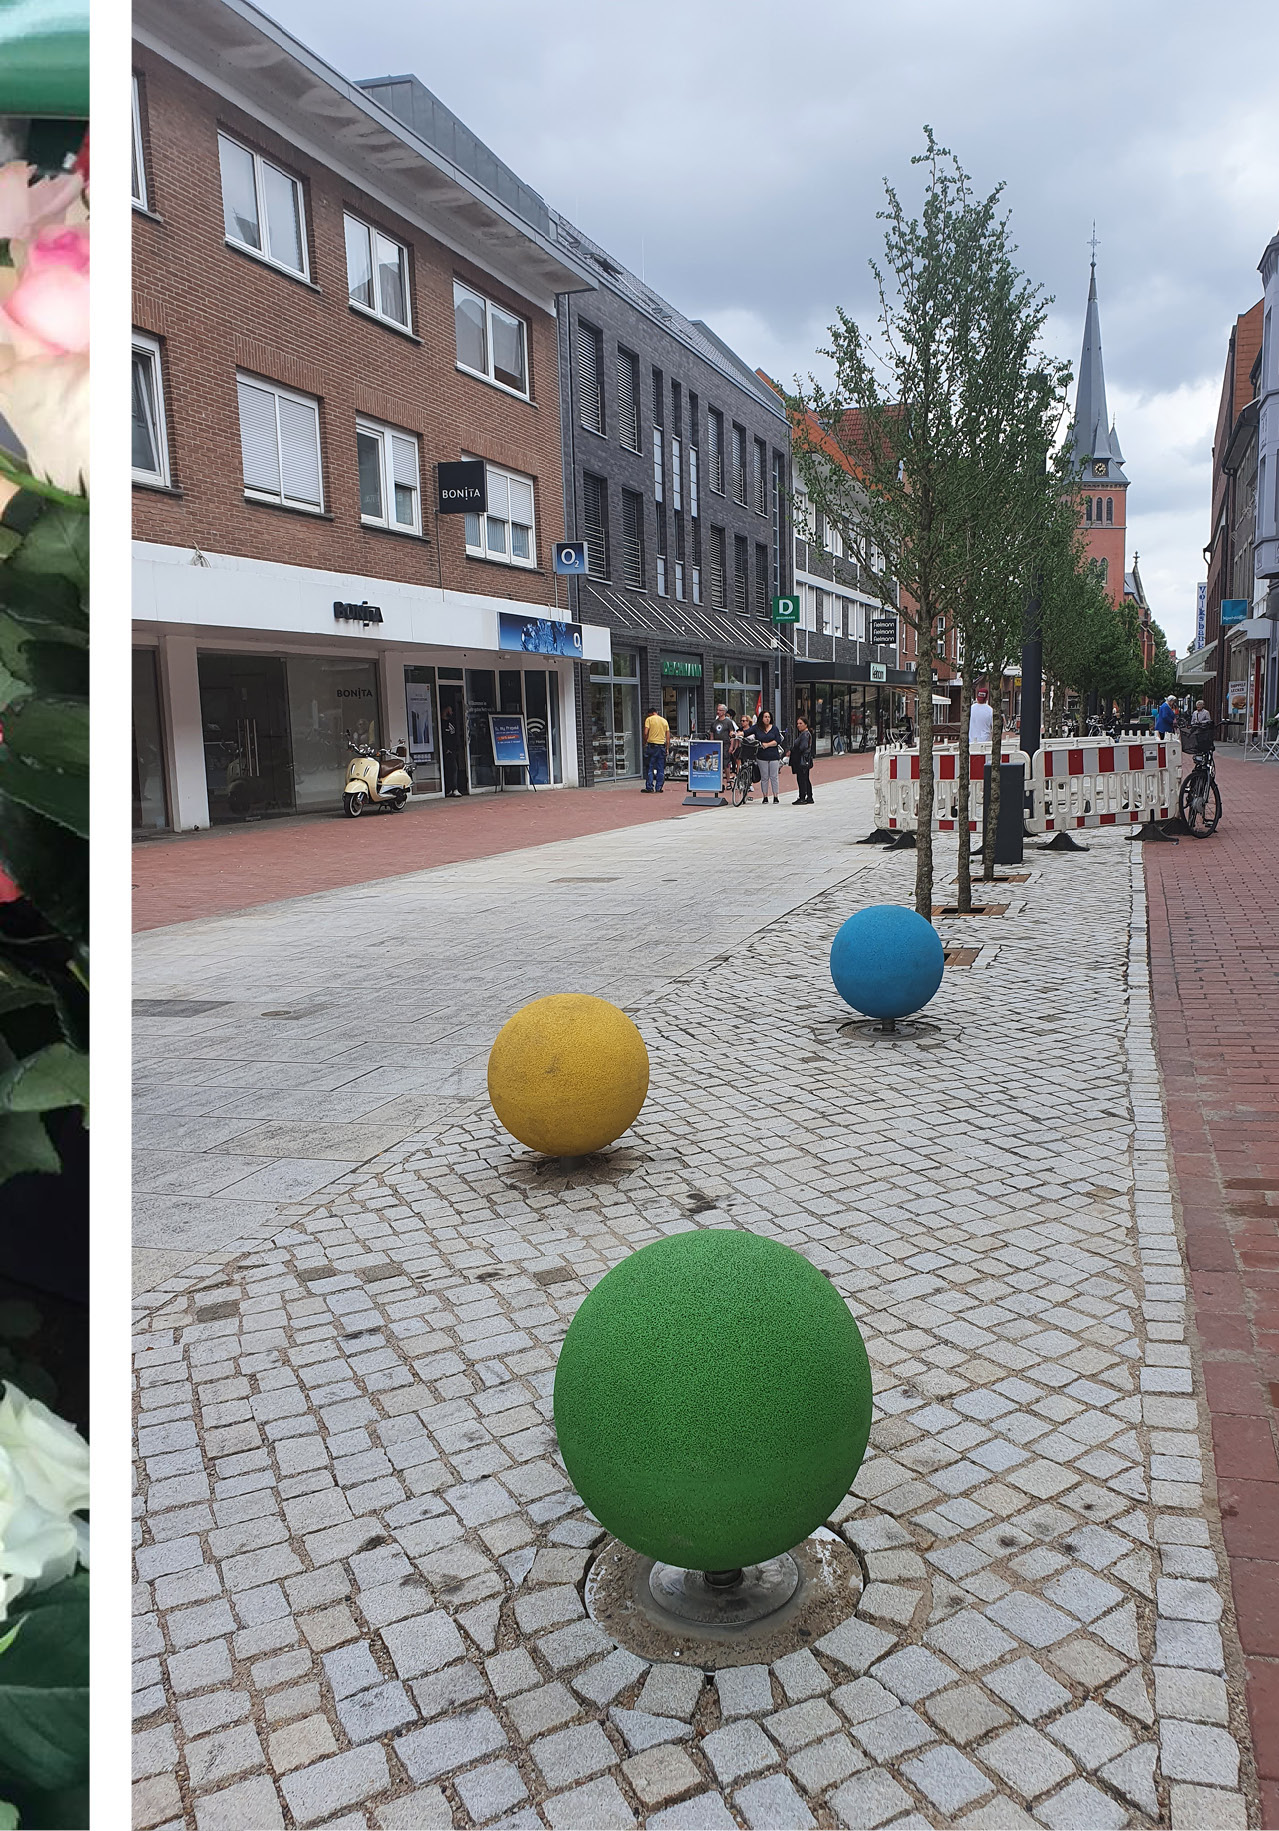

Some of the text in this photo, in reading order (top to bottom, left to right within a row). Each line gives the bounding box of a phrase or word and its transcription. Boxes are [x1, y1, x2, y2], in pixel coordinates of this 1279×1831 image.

[442, 486, 481, 500] BONITA
[333, 601, 384, 627] BONITA
[779, 599, 794, 615] D
[1198, 585, 1206, 649] Volksbank
[336, 687, 373, 700] BONITA
